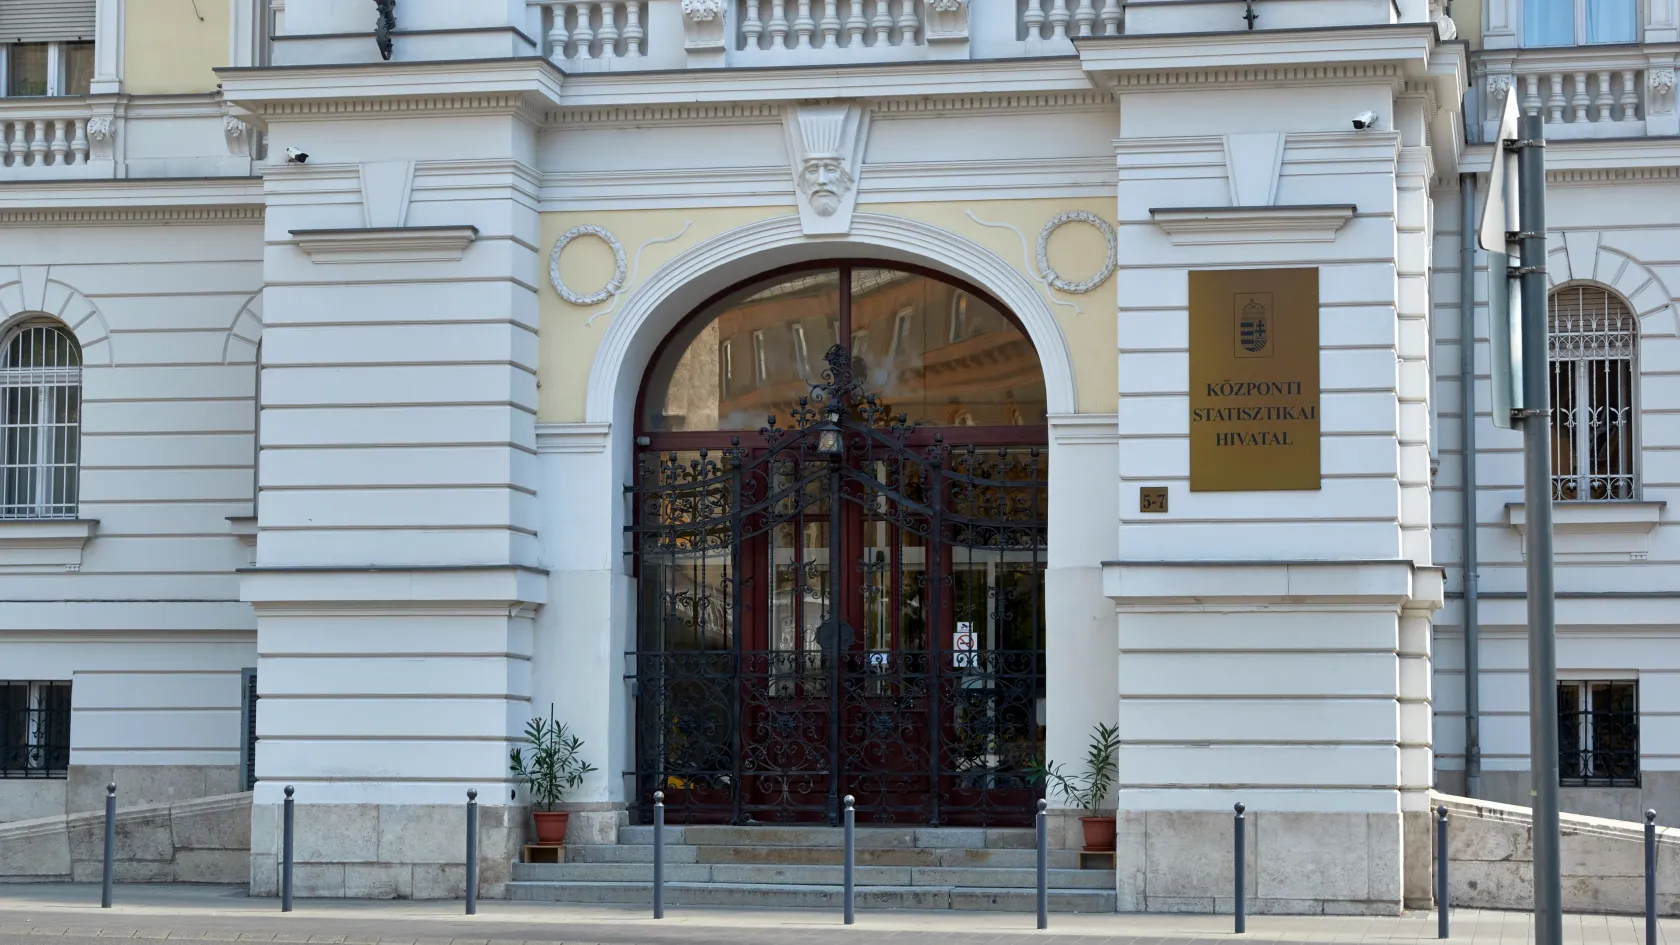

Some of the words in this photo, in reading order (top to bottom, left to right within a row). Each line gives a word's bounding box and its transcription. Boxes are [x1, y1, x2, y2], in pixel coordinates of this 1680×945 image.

[1207, 379, 1302, 397] KÖZPONTI
[1193, 406, 1316, 422] STATISZTIKAI
[1216, 432, 1293, 446] HIVATAL
[1143, 494, 1166, 509] 5-7
